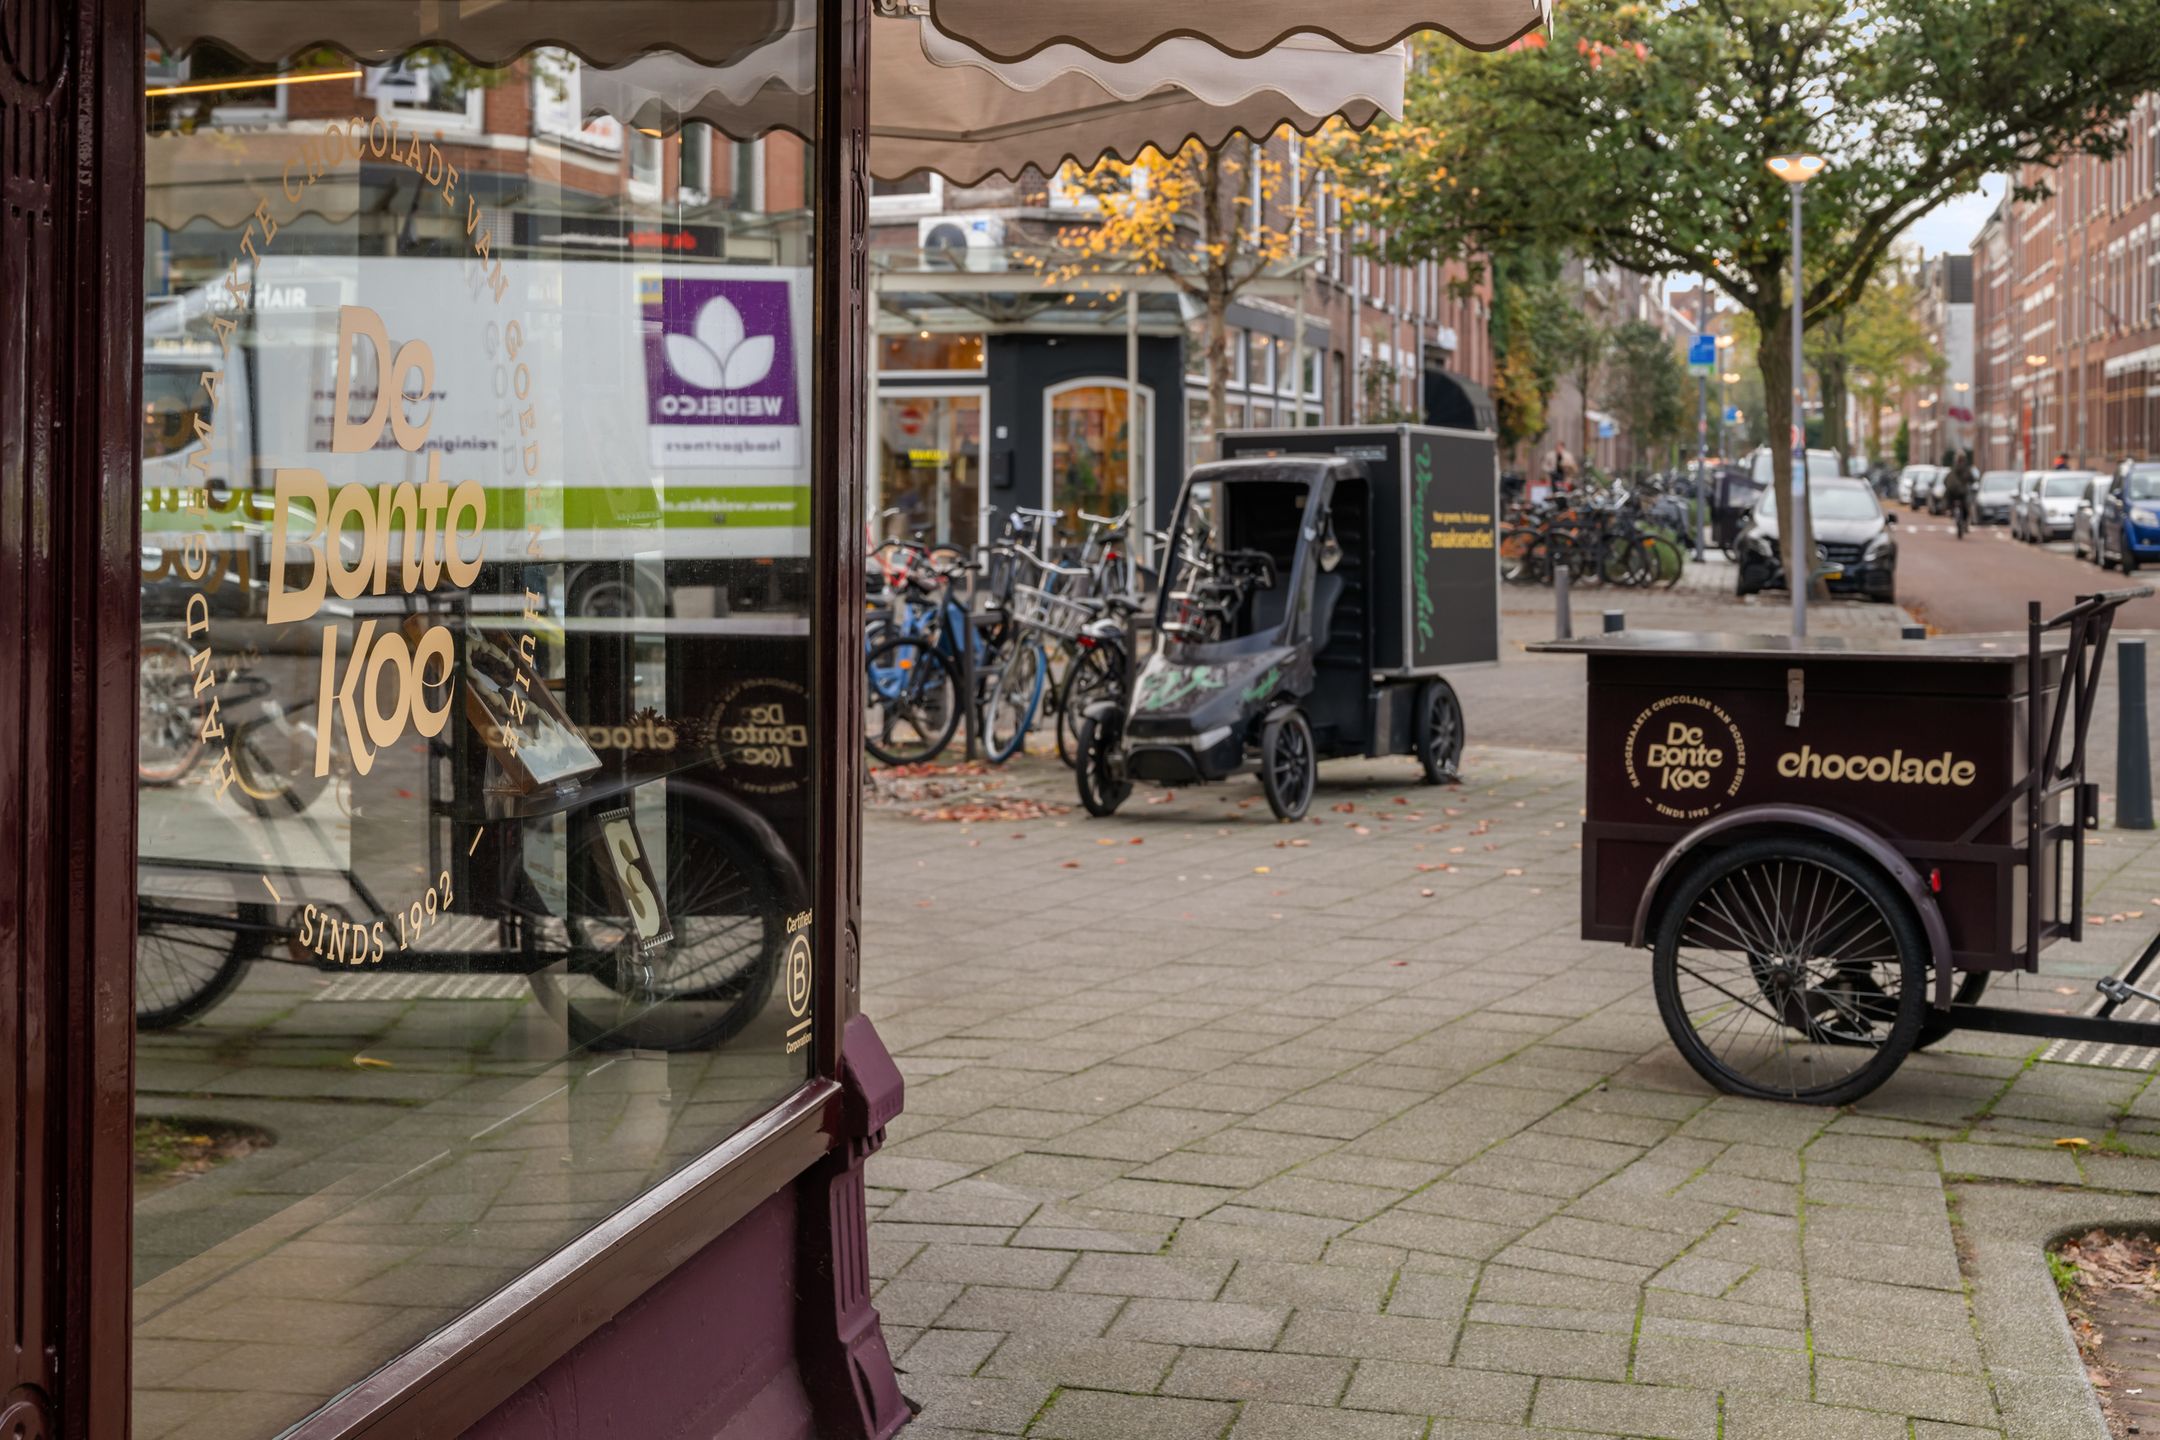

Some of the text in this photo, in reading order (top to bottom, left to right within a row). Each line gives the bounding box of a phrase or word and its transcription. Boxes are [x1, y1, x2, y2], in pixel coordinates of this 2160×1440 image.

[283, 115, 459, 207] CHOCOLADE
[467, 194, 509, 304] VAN
[331, 304, 436, 453] De
[505, 319, 544, 560] GOEDEN
[184, 198, 278, 800] HANDGEMAAKTE
[266, 450, 487, 624] Bonte
[314, 619, 456, 777] Koe
[502, 586, 540, 758] HUIZE
[1651, 695, 1712, 712] CHOCOLADE
[1713, 704, 1732, 724] VAN
[1646, 743, 1723, 768] Bonte
[1660, 766, 1711, 791] Koe
[1666, 721, 1703, 746] De
[1777, 744, 1976, 787] chocolade
[1656, 803, 1685, 819] SINDS
[299, 903, 385, 966] SINDS
[398, 869, 454, 952] 1992
[786, 908, 813, 934] Certified
[786, 1032, 812, 1055] Corporation
